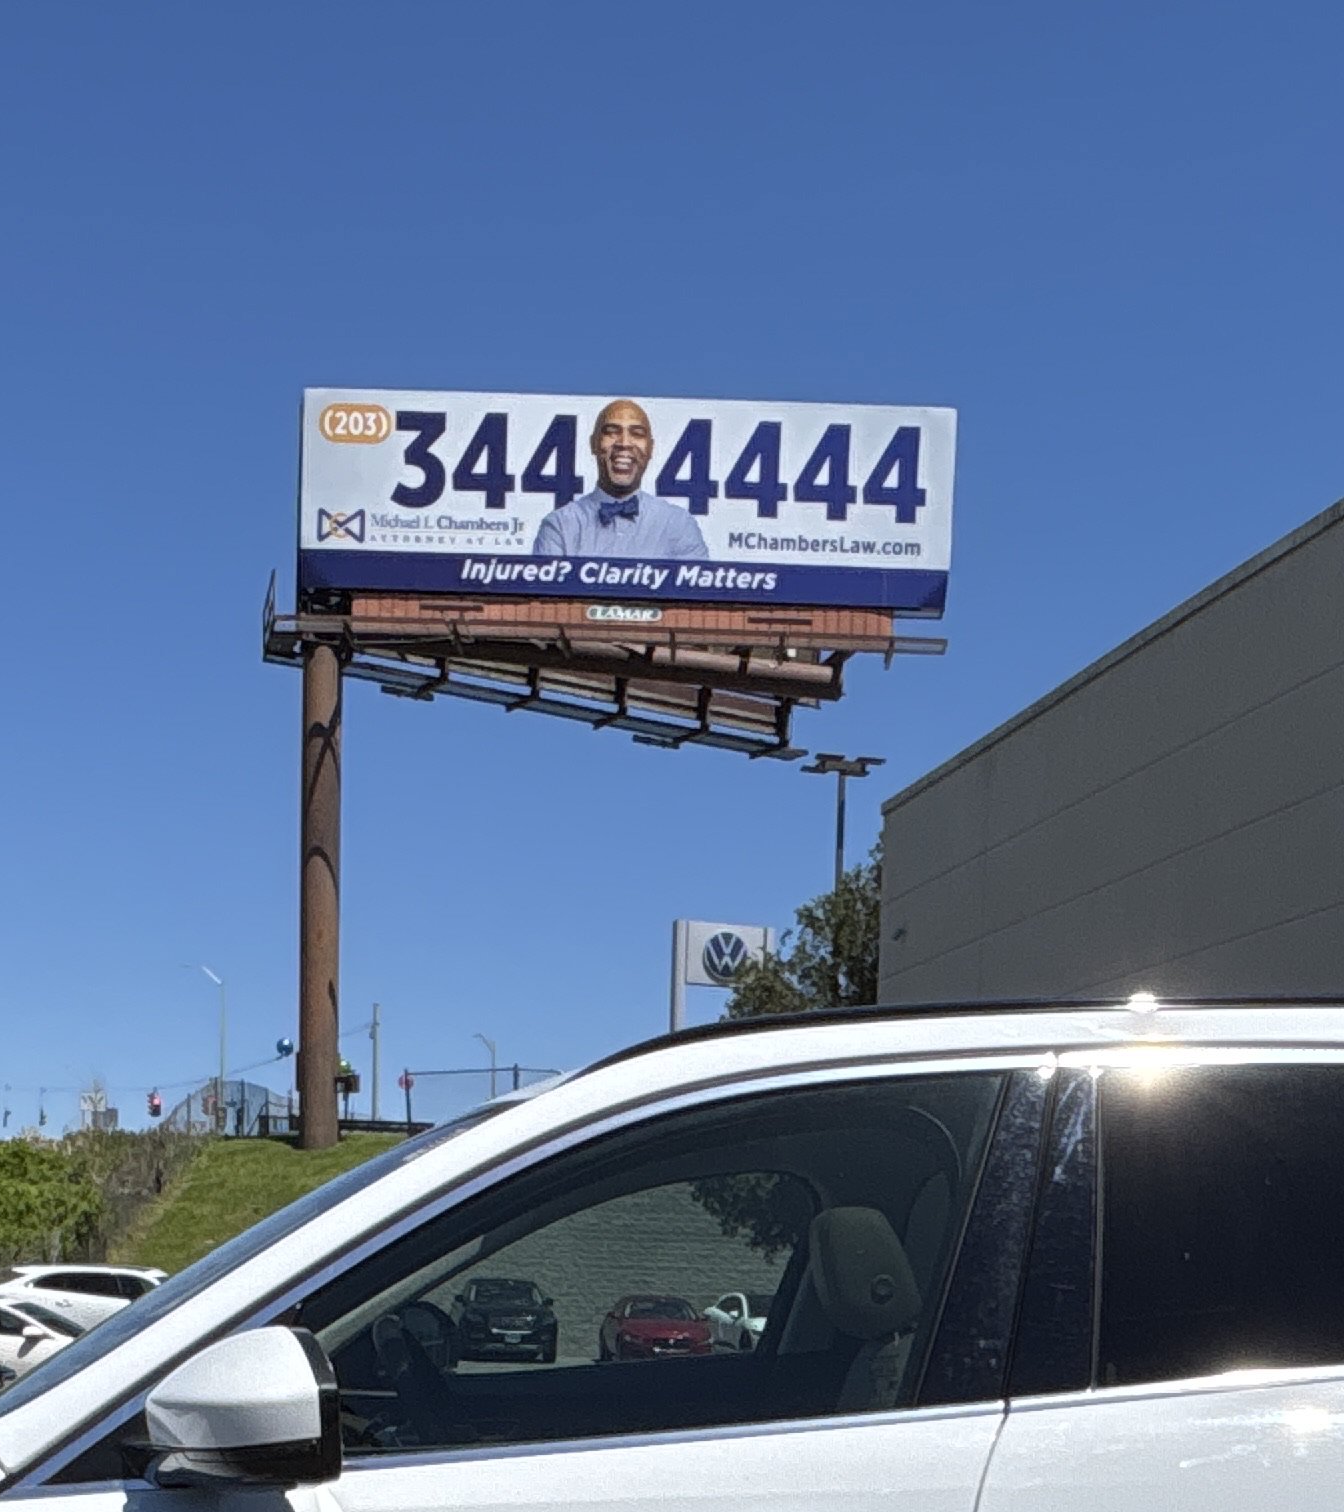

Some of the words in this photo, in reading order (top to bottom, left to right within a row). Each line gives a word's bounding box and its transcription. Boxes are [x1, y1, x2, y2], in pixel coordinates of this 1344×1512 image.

[323, 409, 388, 438] (203)
[390, 410, 584, 509] 344
[655, 418, 927, 524] 4444
[369, 512, 420, 529] Michael
[436, 514, 509, 531] Chambers
[728, 532, 921, 556] MChambersLaw.com
[460, 558, 571, 584] Injured?
[579, 562, 668, 589] Clarity
[675, 566, 777, 590] Matters
